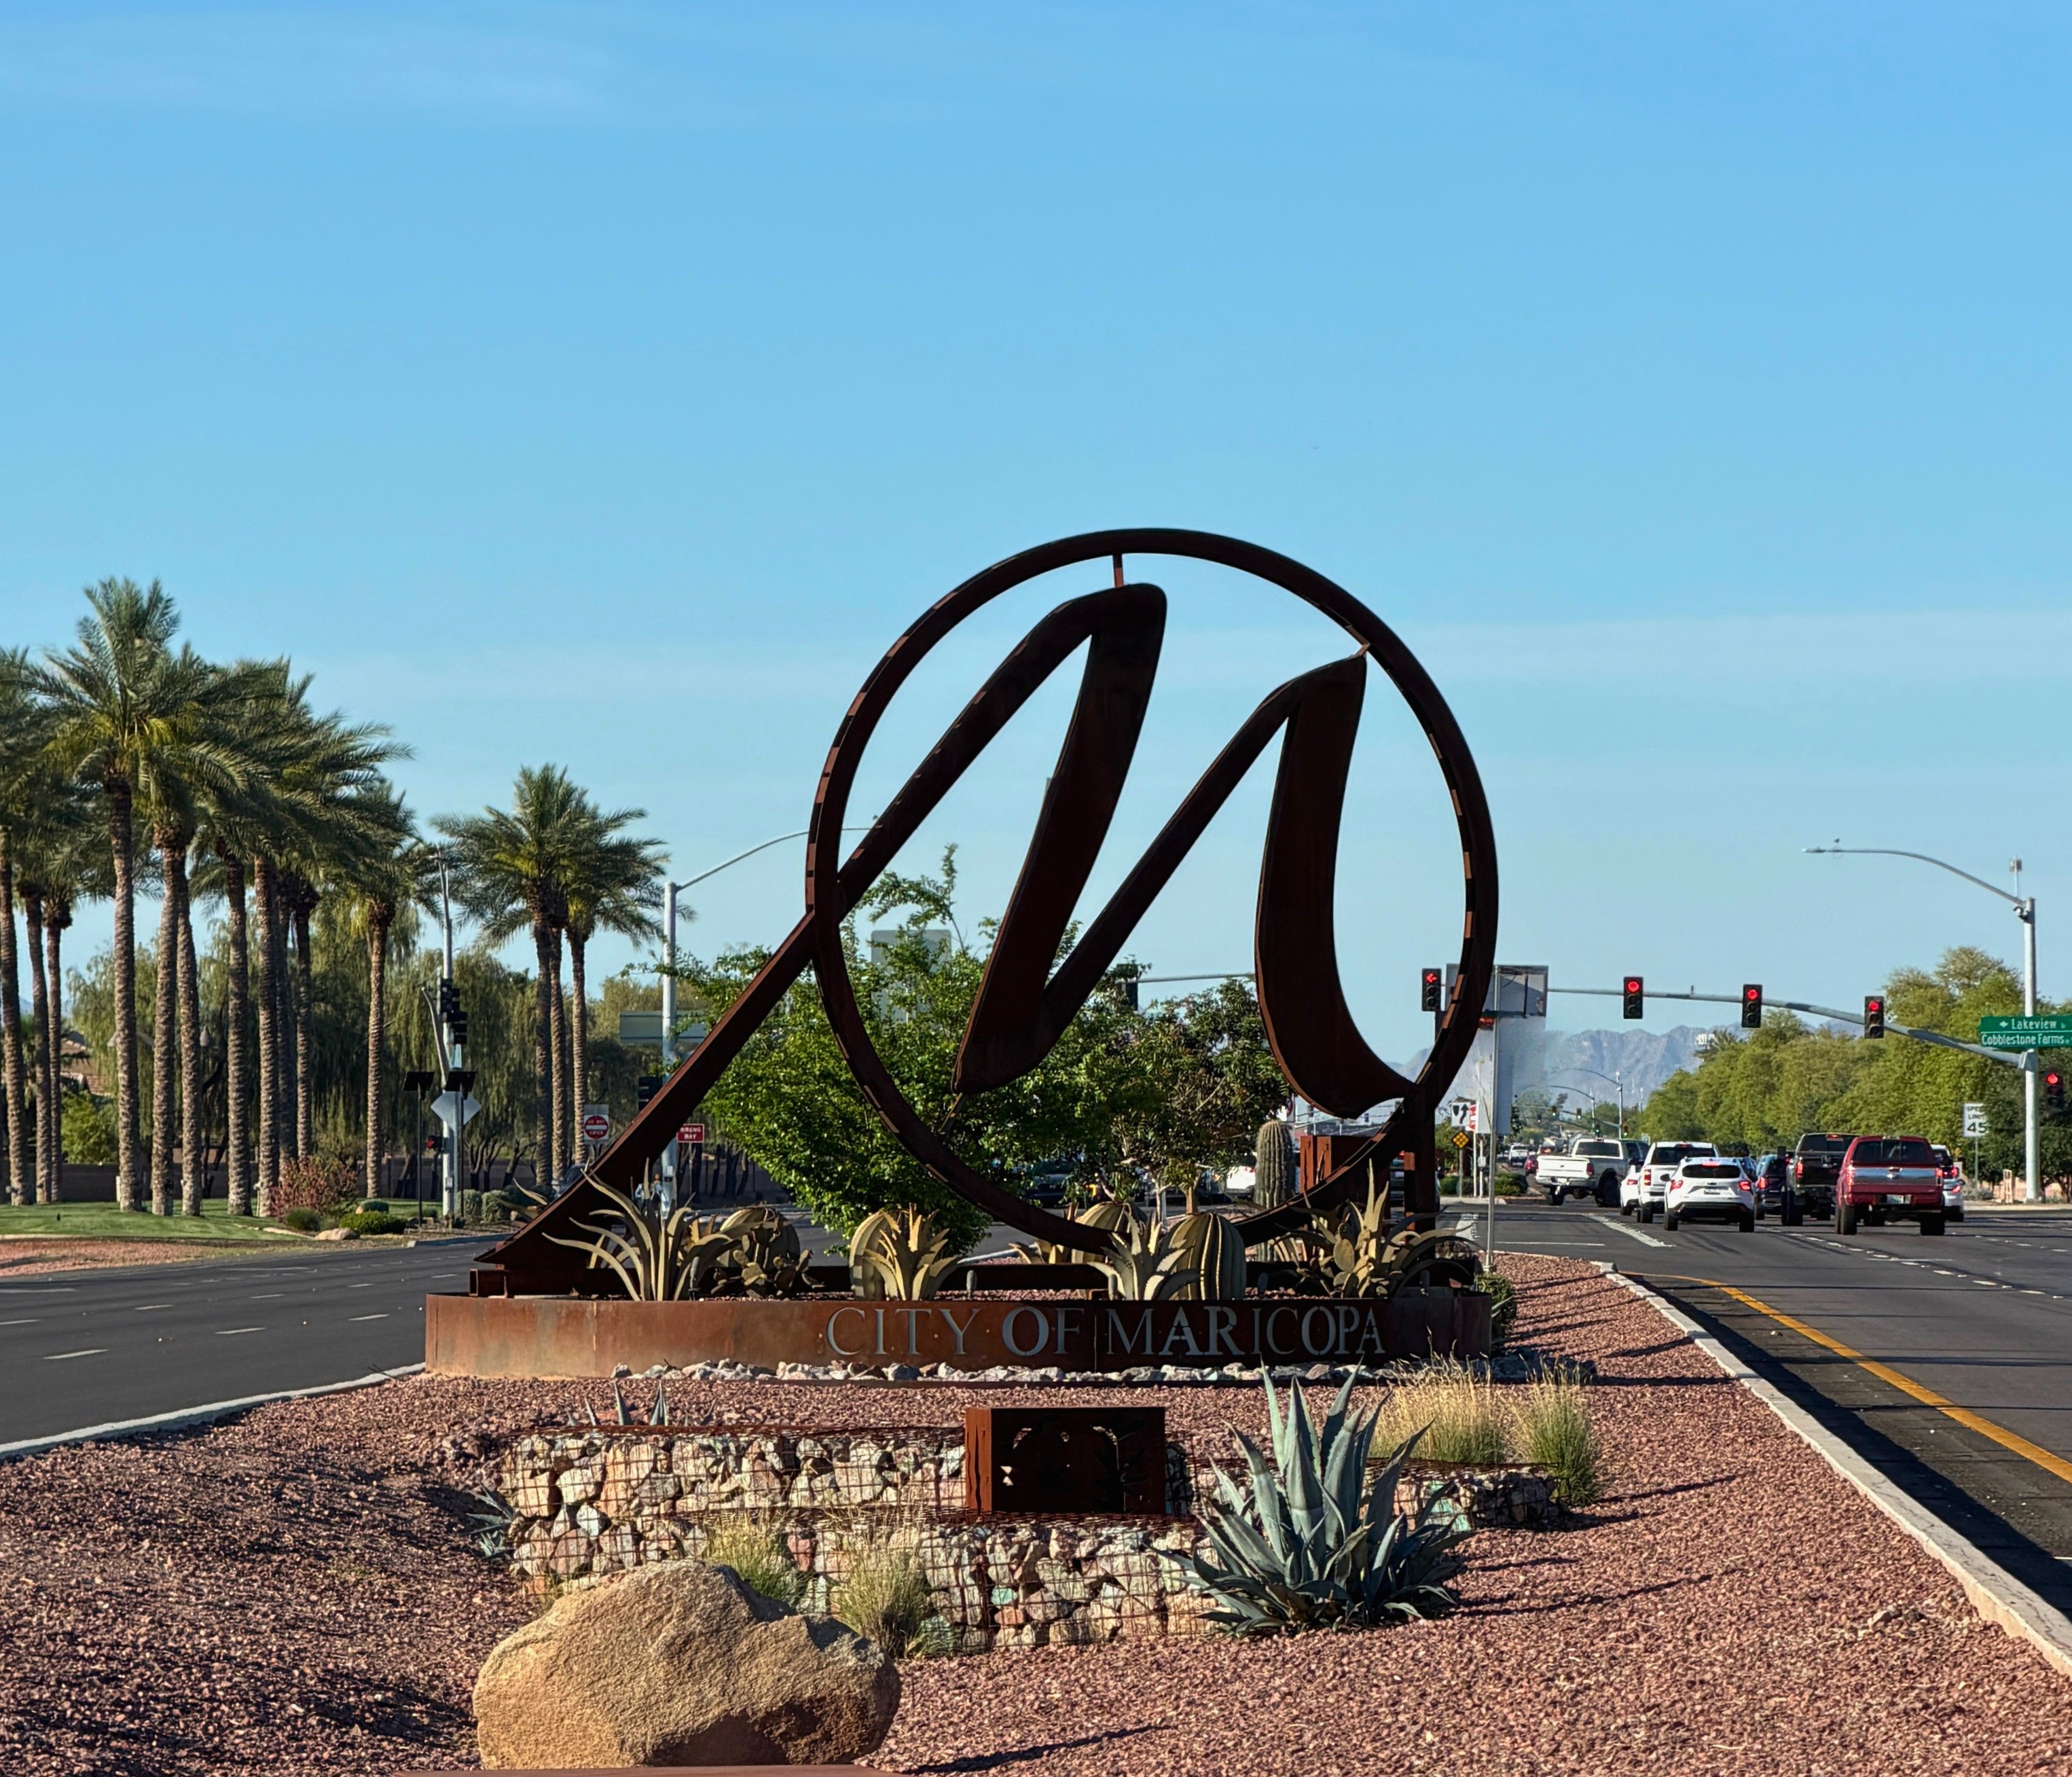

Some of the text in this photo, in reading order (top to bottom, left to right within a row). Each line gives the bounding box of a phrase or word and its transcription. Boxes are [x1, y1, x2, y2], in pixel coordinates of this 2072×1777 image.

[2012, 1018, 2057, 1029] Lakeview
[1981, 1033, 2036, 1045] Cobblestone
[2037, 1033, 2065, 1045] Farms
[1967, 1122, 1988, 1133] 45
[826, 1306, 1386, 1357] CITY OF MARICOPA
